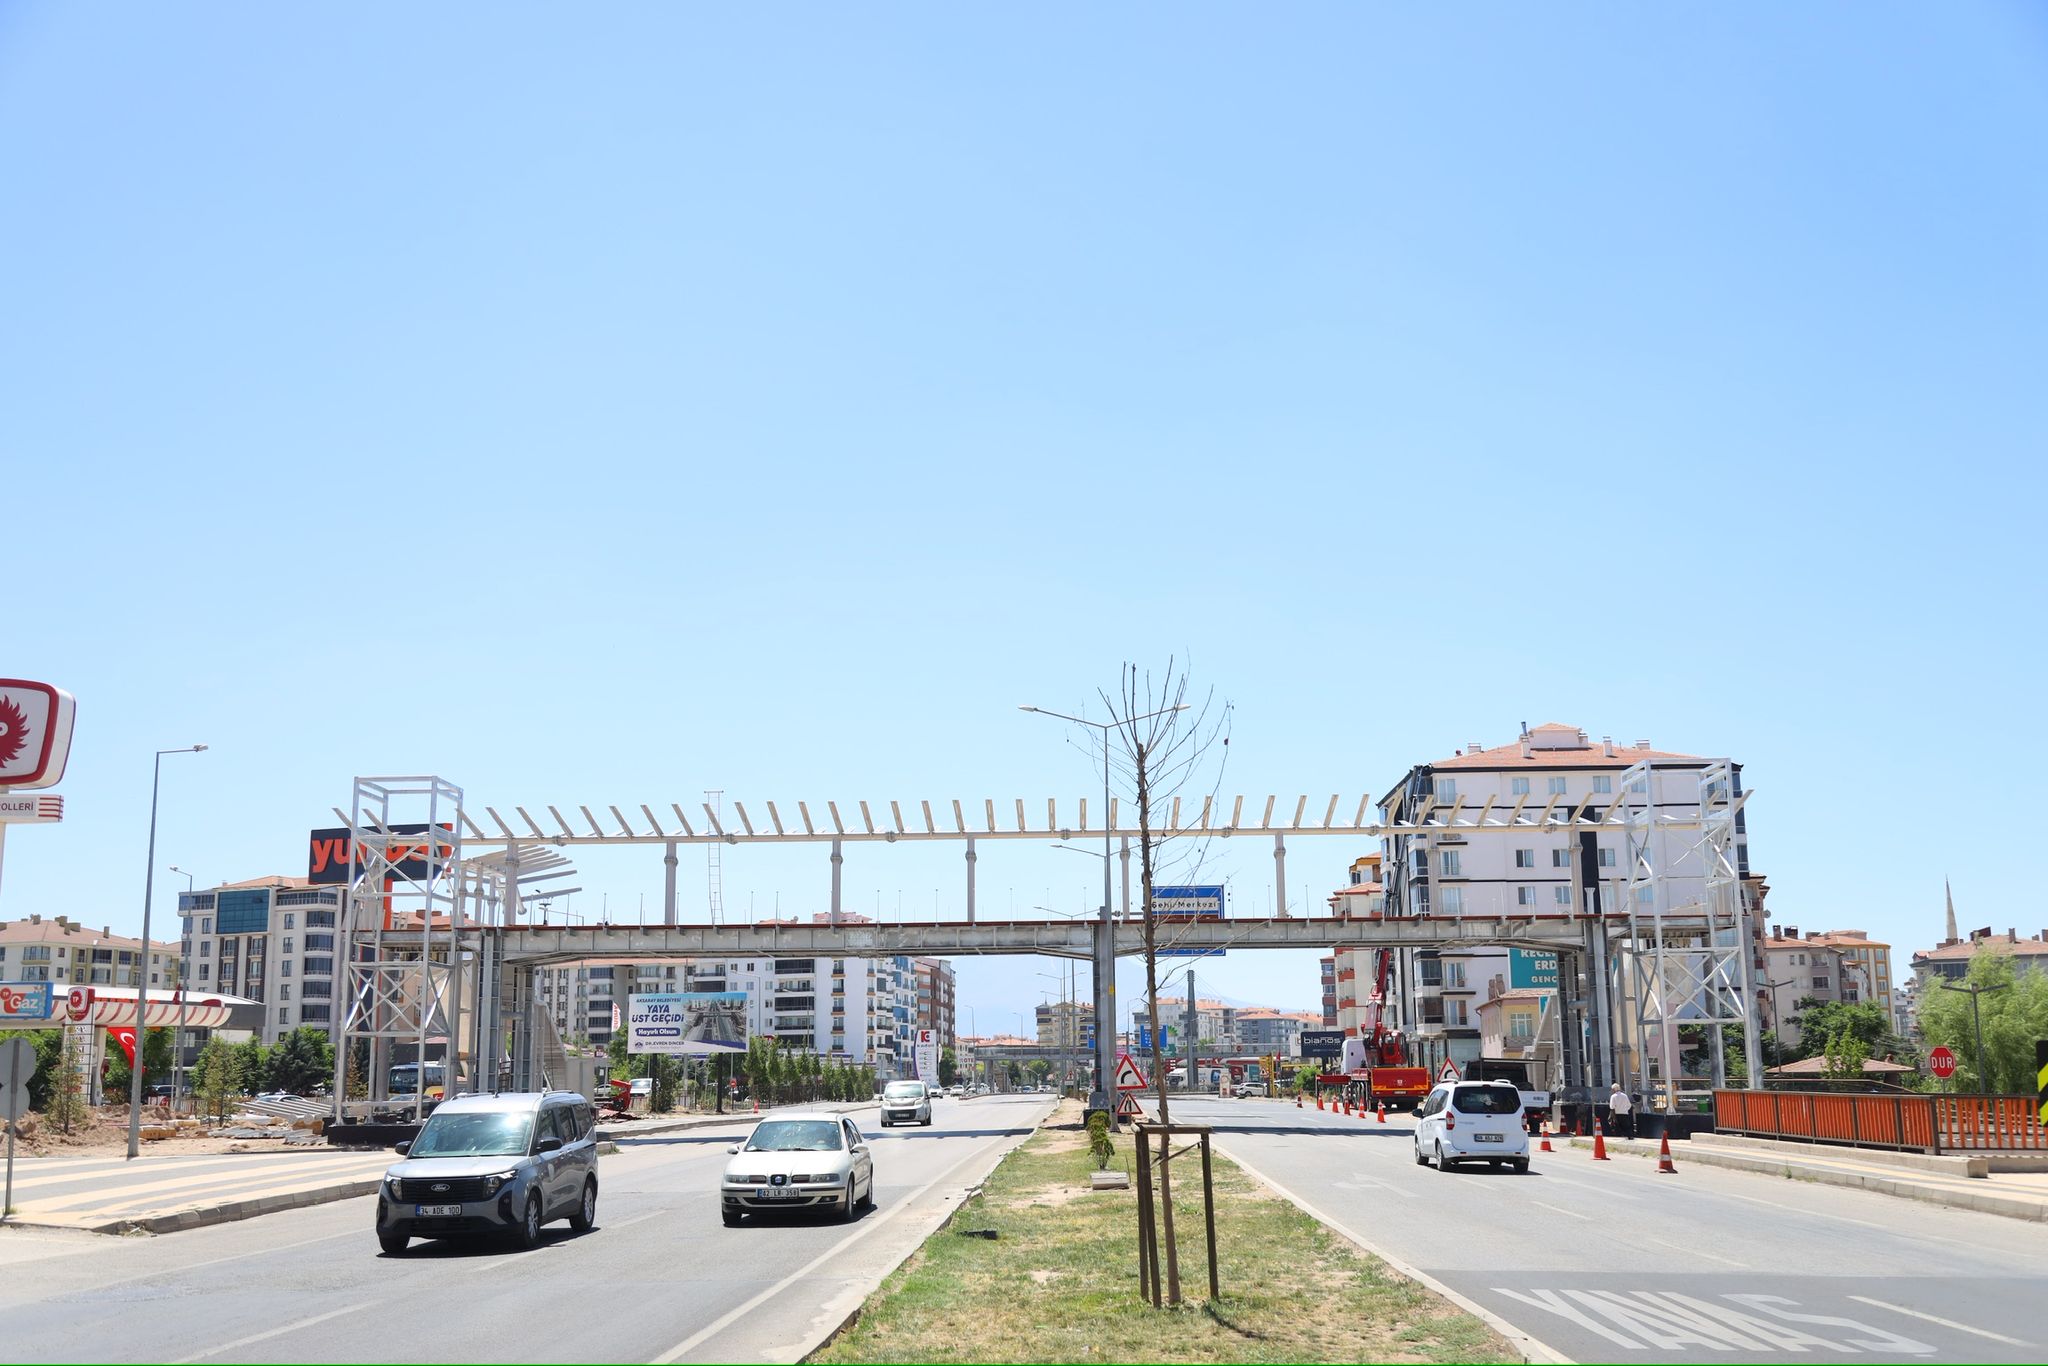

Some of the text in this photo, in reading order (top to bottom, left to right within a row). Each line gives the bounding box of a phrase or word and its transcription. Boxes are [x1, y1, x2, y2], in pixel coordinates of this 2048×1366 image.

[10, 995, 39, 1010] Gaz
[647, 1004, 670, 1014] YAYA
[651, 1014, 684, 1024] GEÇİDİ
[1931, 1056, 1953, 1069] DUR
